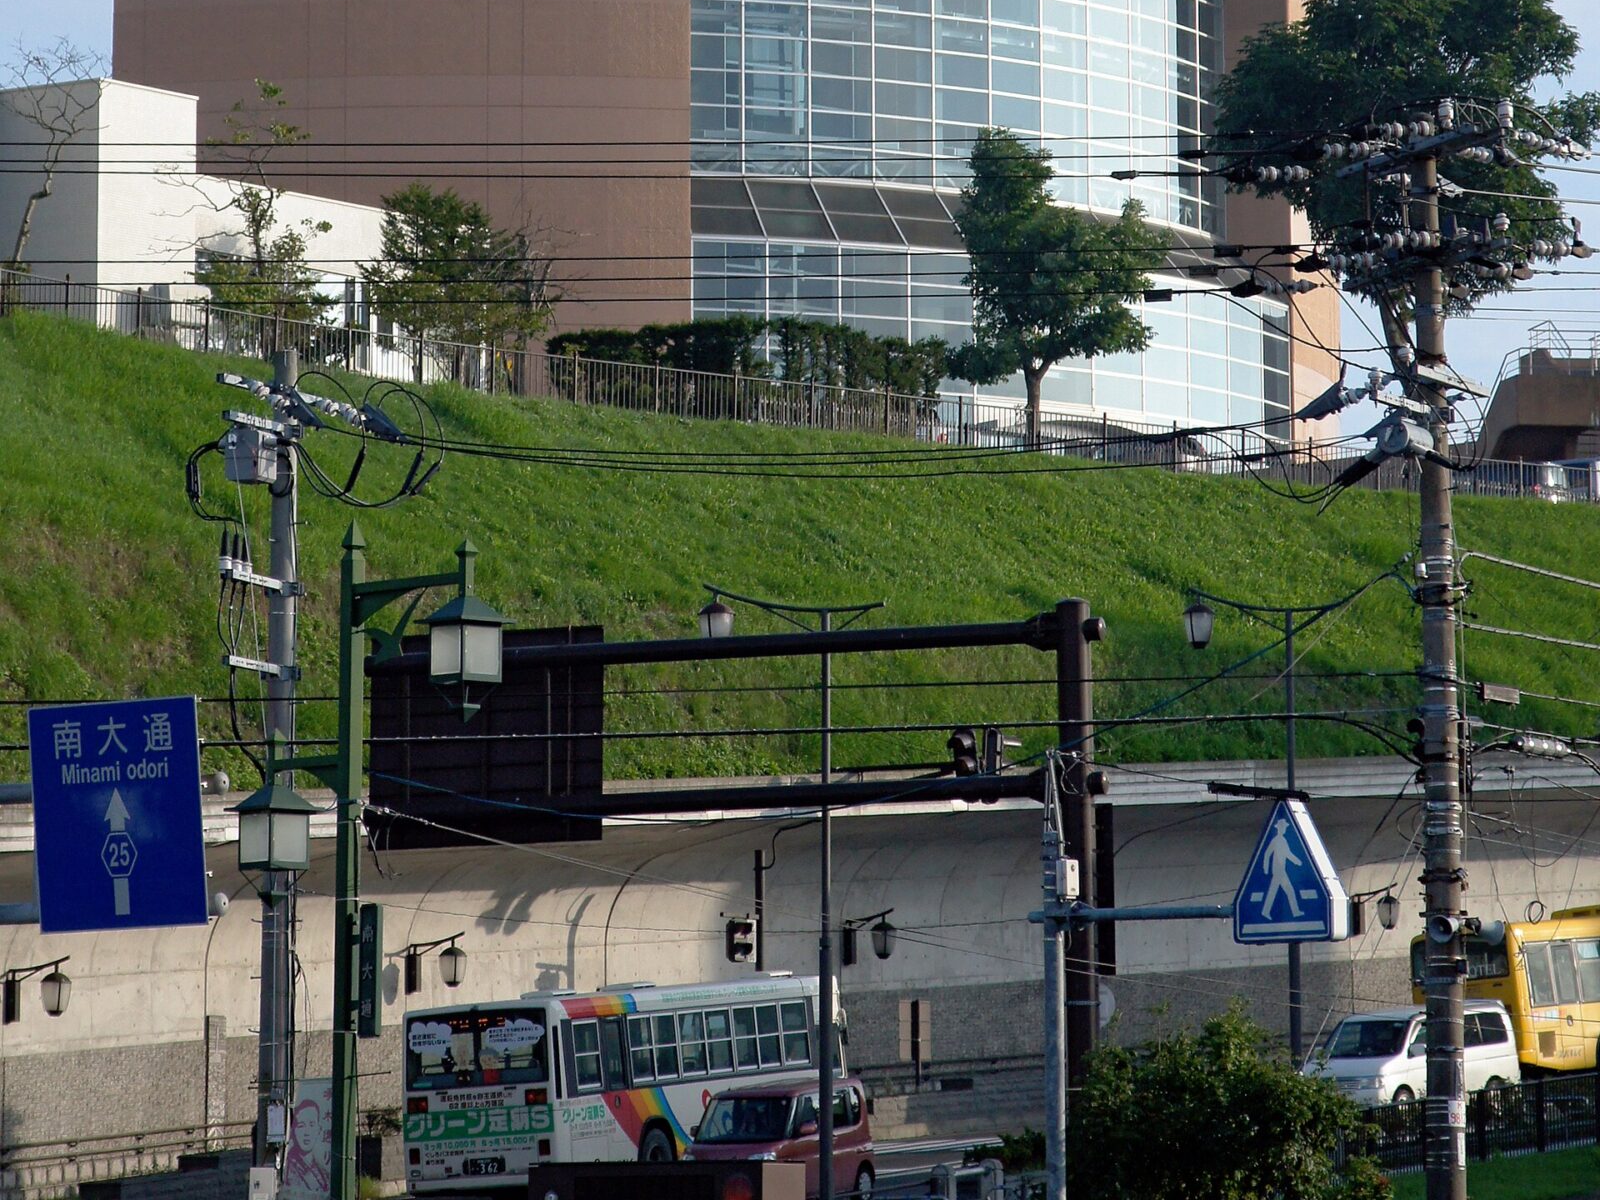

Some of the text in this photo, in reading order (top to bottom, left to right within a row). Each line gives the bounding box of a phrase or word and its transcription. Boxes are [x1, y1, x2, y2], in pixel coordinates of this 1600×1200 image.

[52, 713, 173, 760] 南大通
[62, 757, 168, 784] Minami odori
[109, 843, 129, 867] 25
[361, 925, 374, 1020] 南大通
